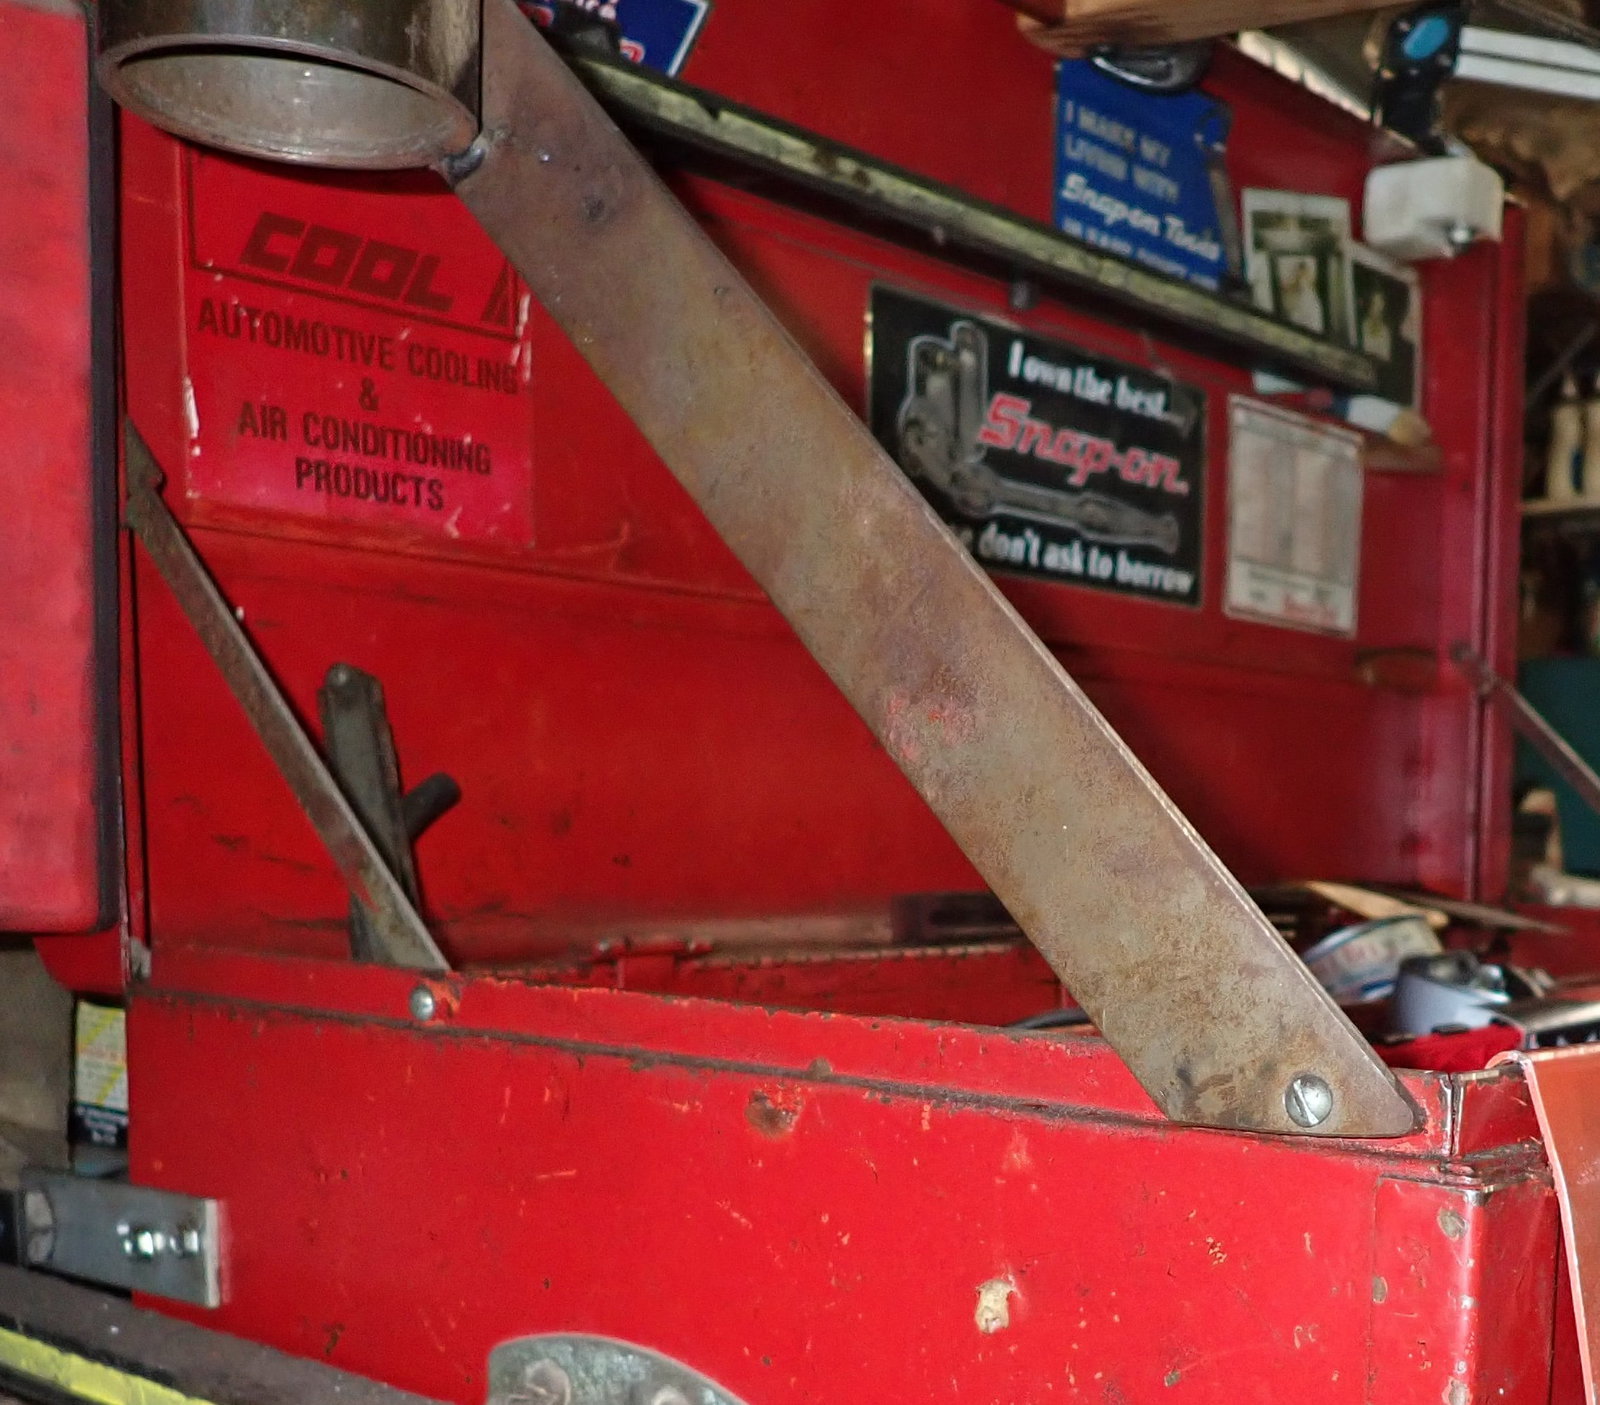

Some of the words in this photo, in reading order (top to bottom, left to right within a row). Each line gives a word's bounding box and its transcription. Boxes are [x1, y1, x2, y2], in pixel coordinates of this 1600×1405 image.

[242, 212, 453, 311] COOL
[199, 299, 395, 371] AUTOMOTIVE
[407, 342, 518, 395] COOLING
[1008, 340, 1024, 378] I
[1073, 366, 1112, 405] the
[358, 377, 379, 411] &
[238, 401, 288, 442] AIR
[302, 411, 492, 476] CONDITIONING
[976, 393, 1188, 496] Snap-on
[294, 456, 444, 511] PRODUCTS
[1043, 541, 1083, 574] ask
[1087, 546, 1113, 579] to
